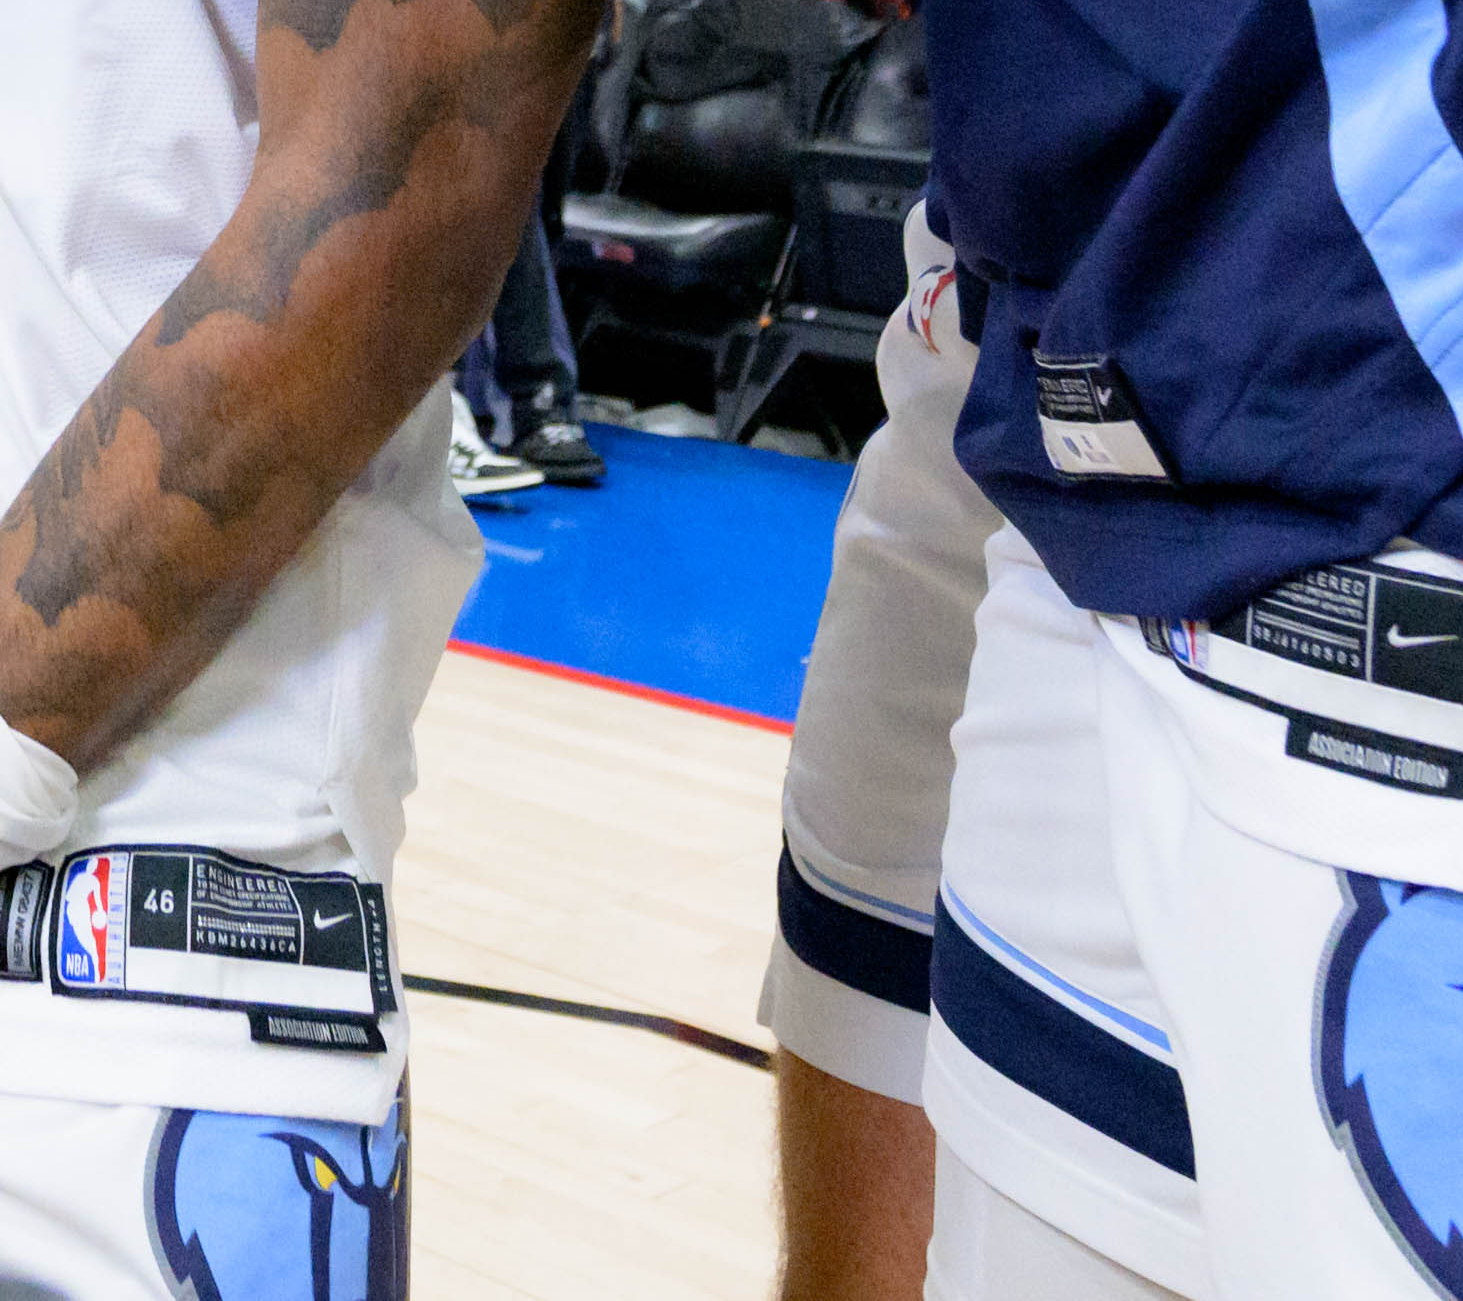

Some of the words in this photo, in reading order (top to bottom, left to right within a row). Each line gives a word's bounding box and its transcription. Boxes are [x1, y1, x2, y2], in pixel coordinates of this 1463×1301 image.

[197, 864, 287, 893] ENGINEERED
[142, 888, 175, 914] 46
[65, 953, 90, 977] NBA
[267, 1015, 332, 1043] ASSOCIATION
[331, 1023, 370, 1045] EDITION
